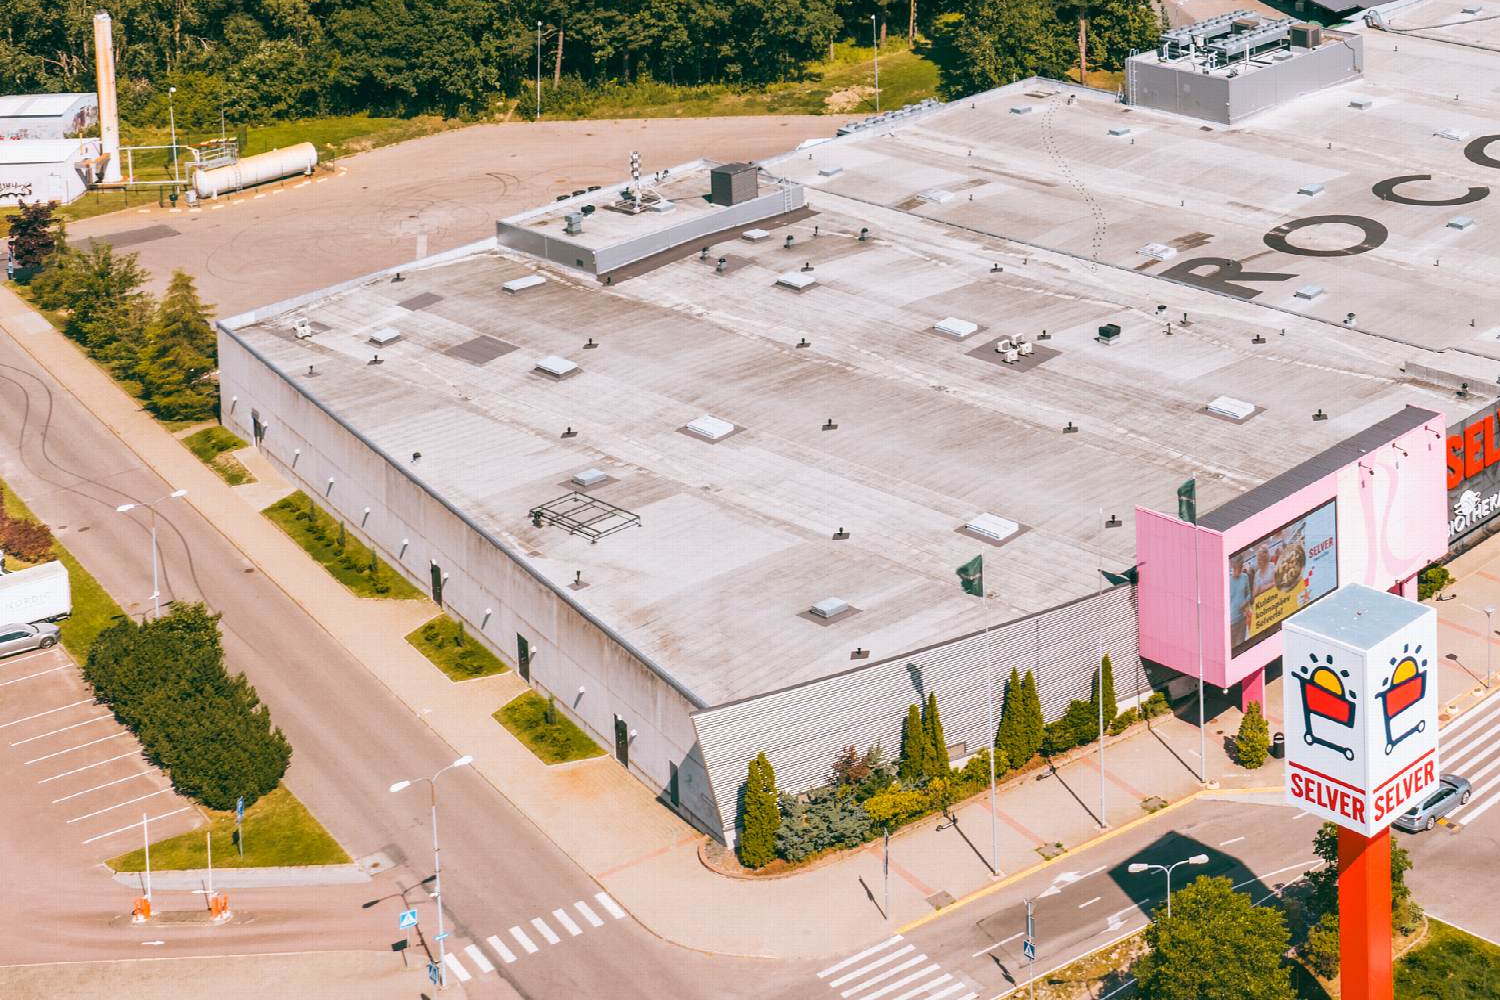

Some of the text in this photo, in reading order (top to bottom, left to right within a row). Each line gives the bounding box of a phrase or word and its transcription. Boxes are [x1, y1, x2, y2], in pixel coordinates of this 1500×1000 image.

[1309, 537, 1334, 559] SELVER
[1291, 772, 1366, 824] SELVER
[1374, 759, 1435, 822] SELVER
